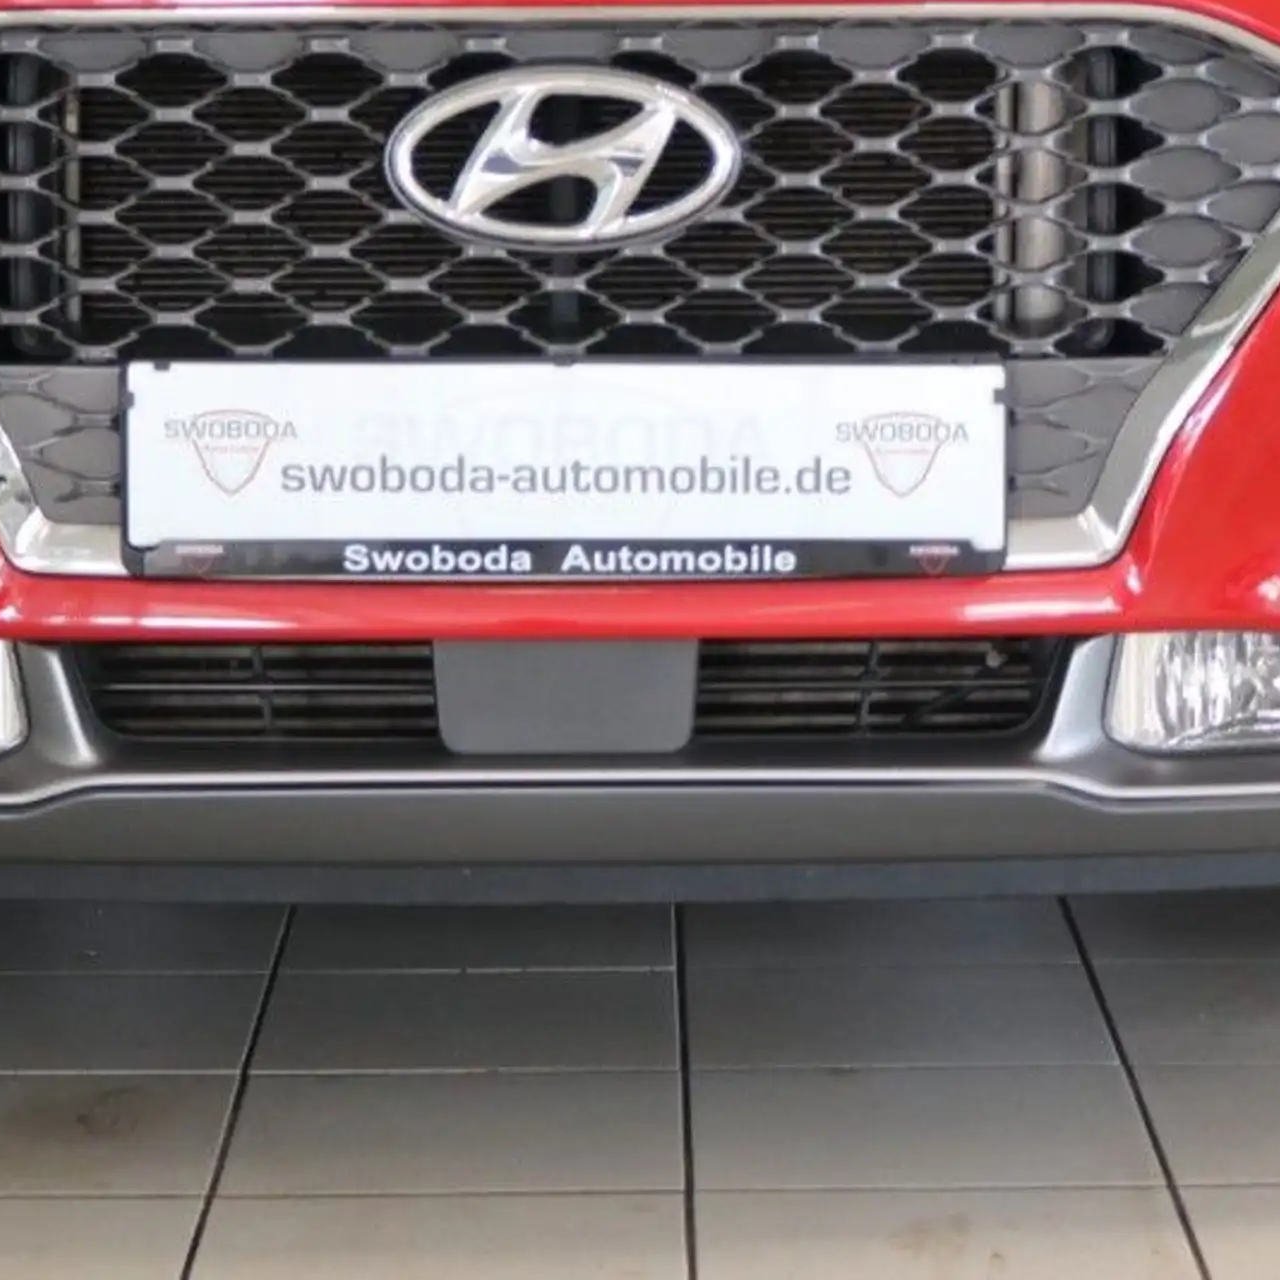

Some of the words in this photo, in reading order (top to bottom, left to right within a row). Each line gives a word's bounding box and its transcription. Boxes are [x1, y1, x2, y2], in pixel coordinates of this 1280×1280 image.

[164, 419, 298, 440] SWOBODA
[835, 421, 969, 443] SWOBODA
[280, 454, 853, 495] swoboda-automobile.de
[343, 544, 533, 573] Swoboda
[561, 545, 798, 573] Automobile
